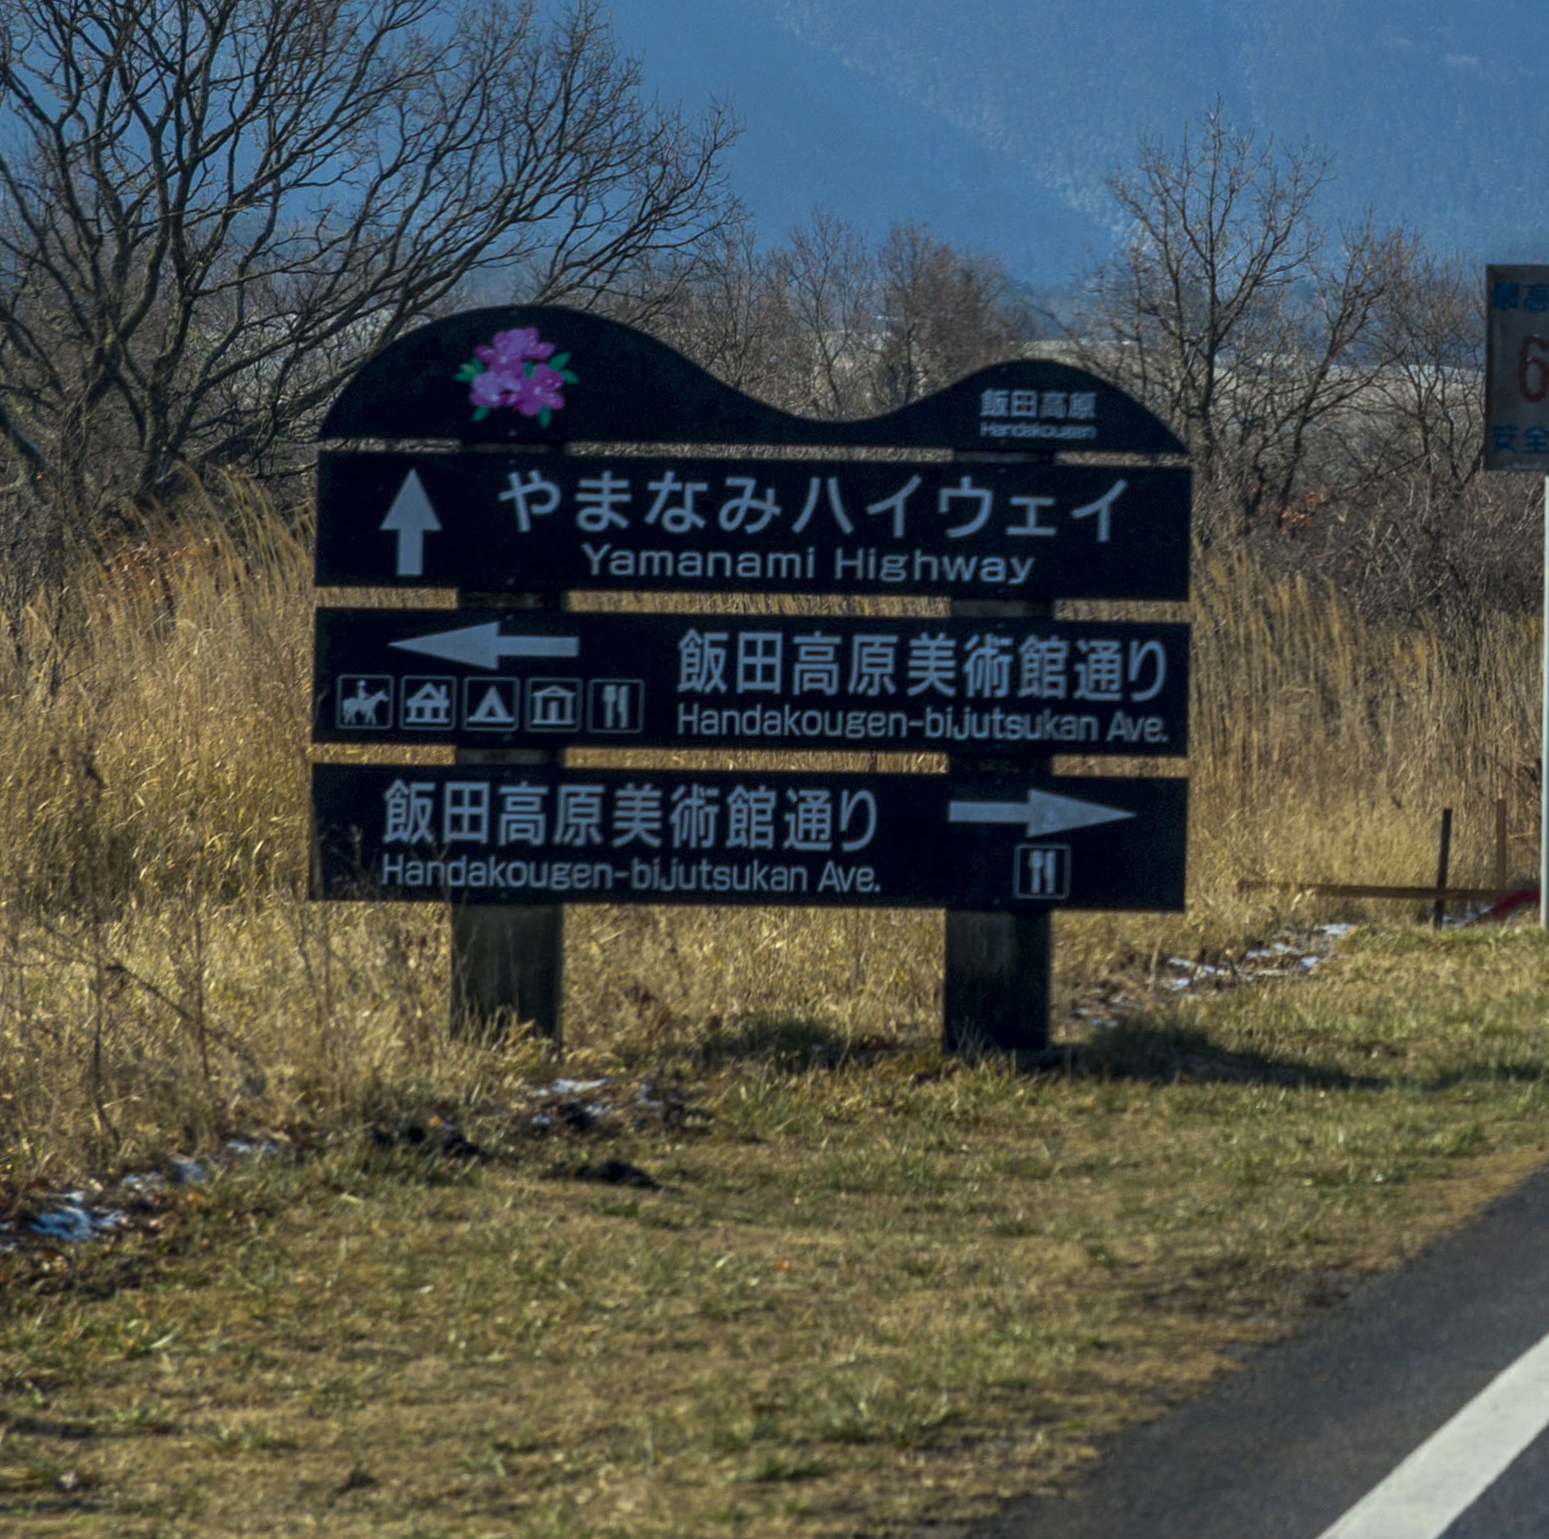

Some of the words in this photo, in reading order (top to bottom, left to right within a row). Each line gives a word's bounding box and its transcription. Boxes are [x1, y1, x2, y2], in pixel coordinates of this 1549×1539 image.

[979, 388, 1098, 420] 飯田高原
[980, 422, 1098, 440] Handakougen
[499, 470, 1128, 542] やまなみハイウェイ
[580, 543, 816, 580] Yamanami
[834, 547, 1036, 585] Highway
[676, 628, 1167, 702] 飯田高原美術館通り
[676, 702, 1099, 741] Handakougen-bijutsukan
[1106, 710, 1170, 744] Ave.
[382, 779, 878, 852] 飯田高原美術館通り
[381, 854, 808, 892] Handakougen-bijutsukan
[817, 860, 882, 893] Ave.
